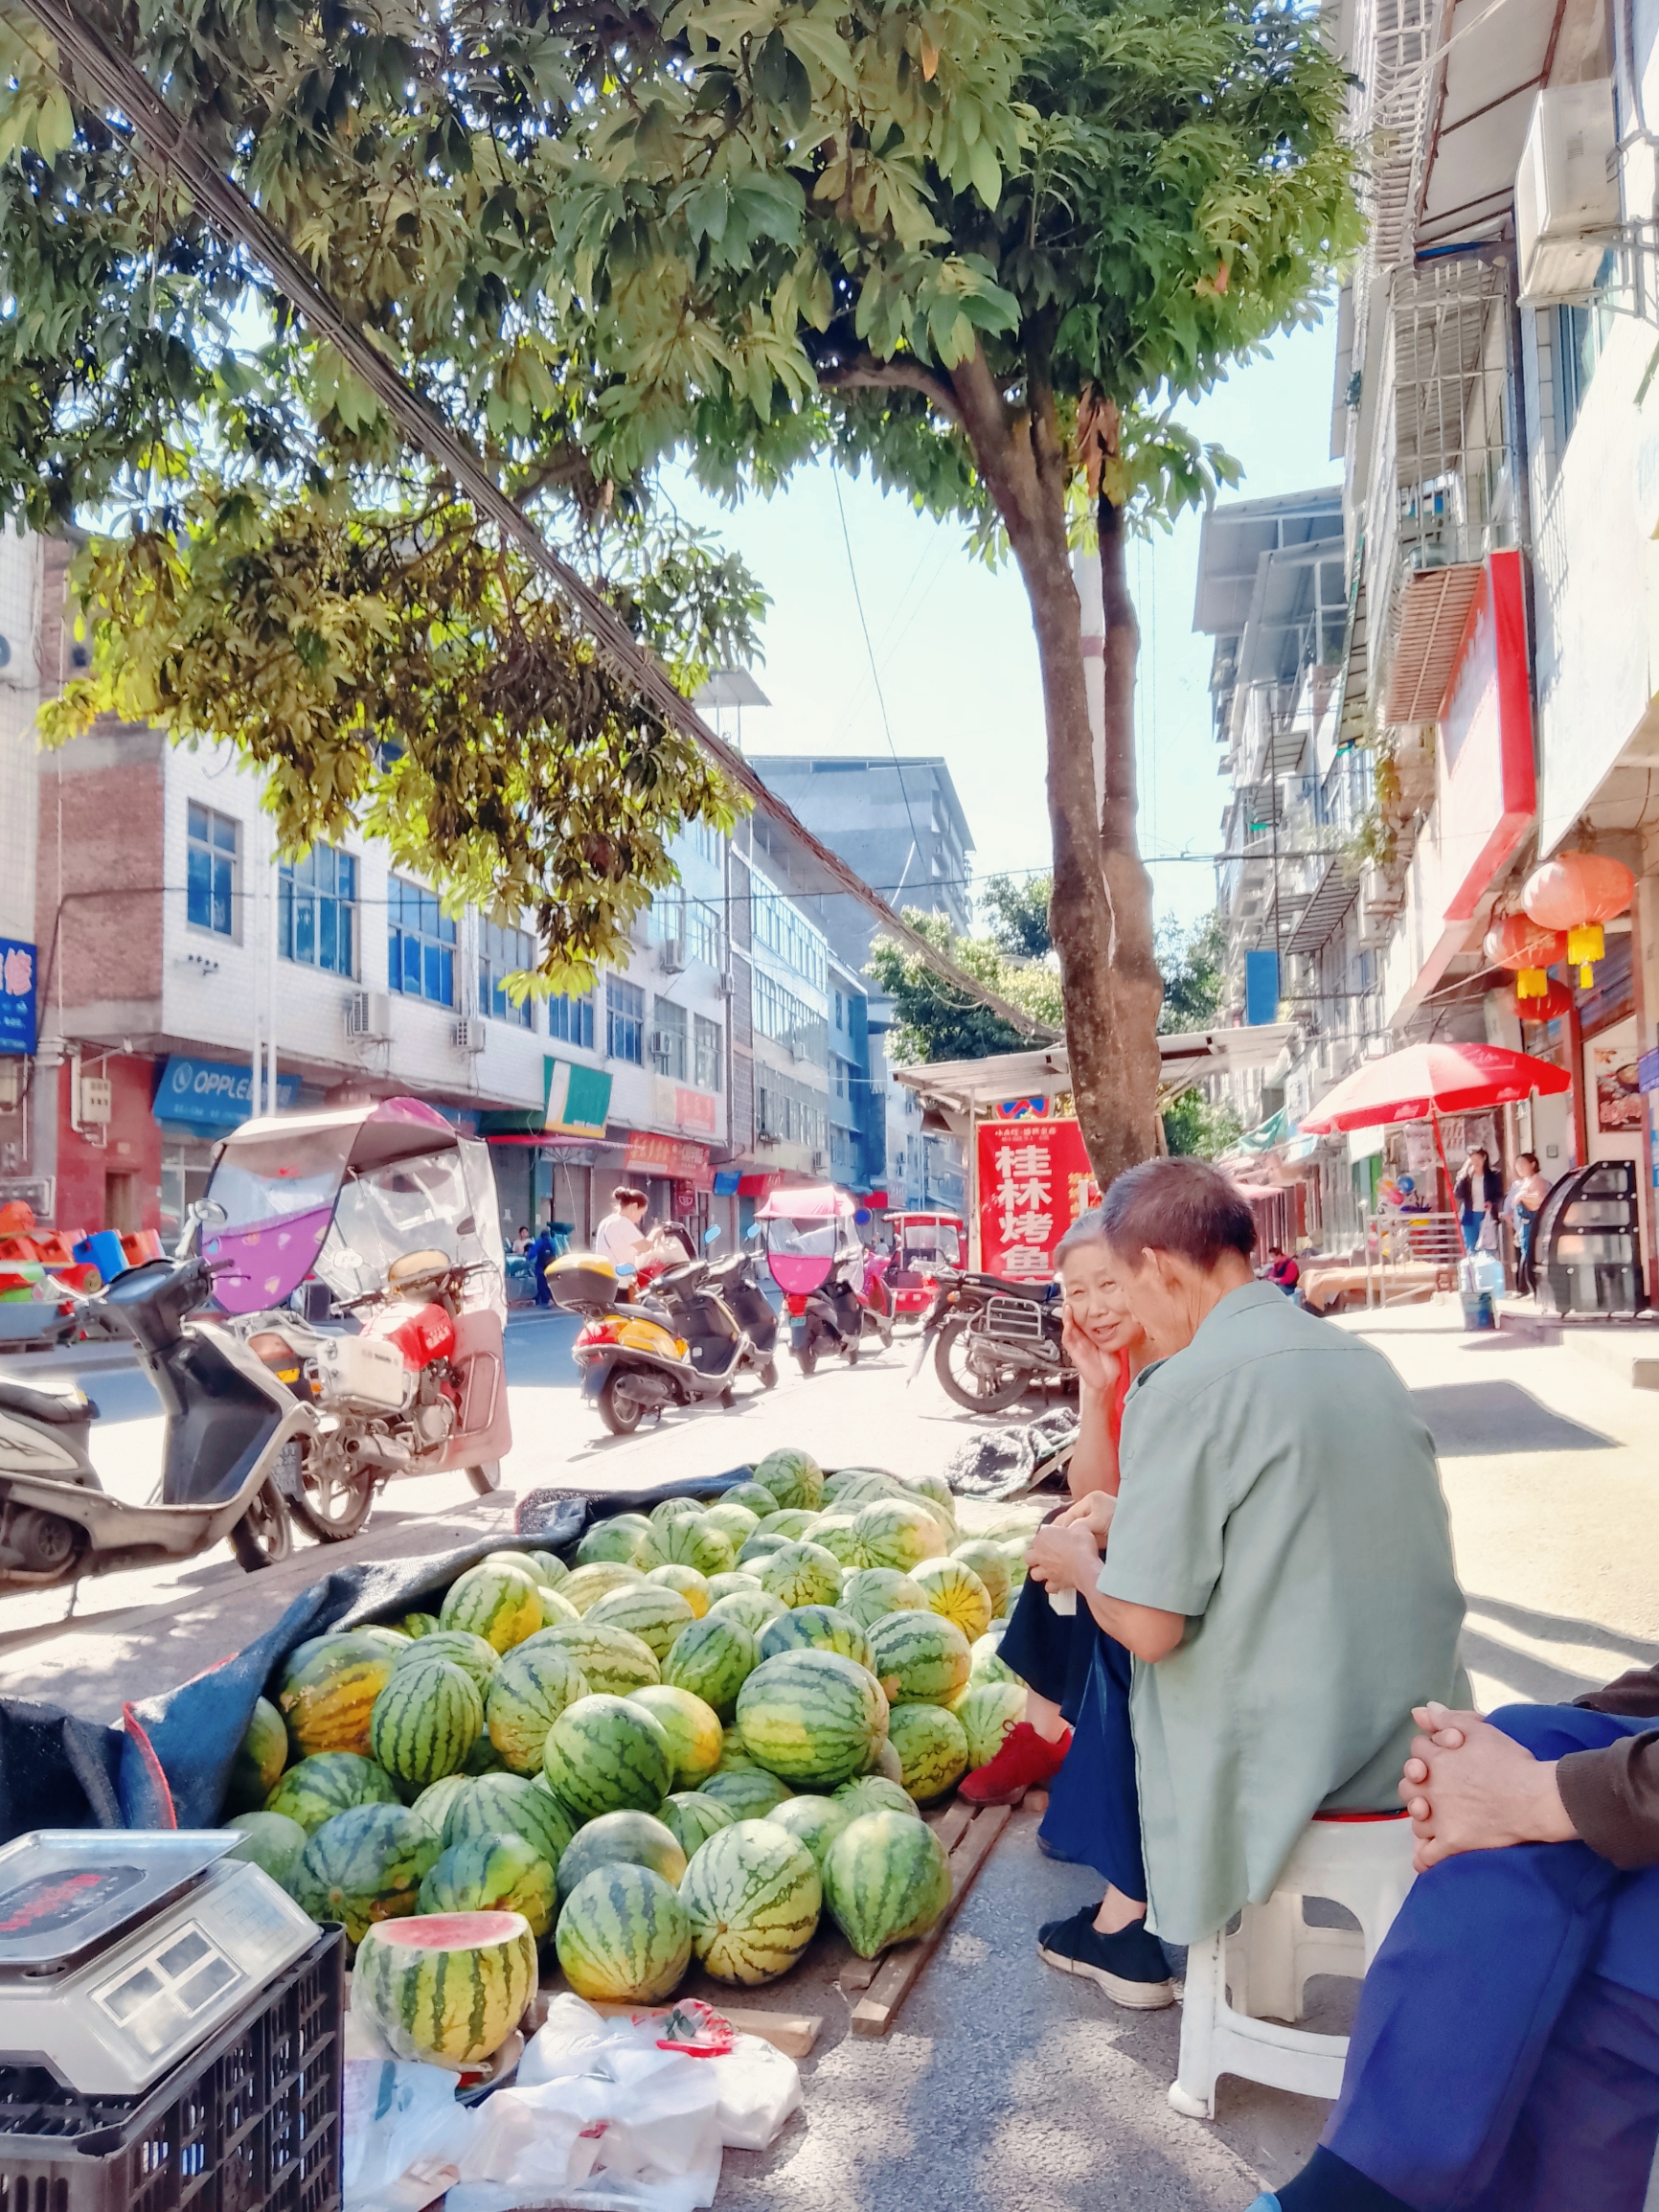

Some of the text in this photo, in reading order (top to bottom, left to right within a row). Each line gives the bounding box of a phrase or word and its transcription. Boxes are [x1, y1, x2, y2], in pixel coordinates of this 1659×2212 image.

[193, 1070, 250, 1100] OPPLE
[994, 1144, 1055, 1285] 桂林烤鱼
